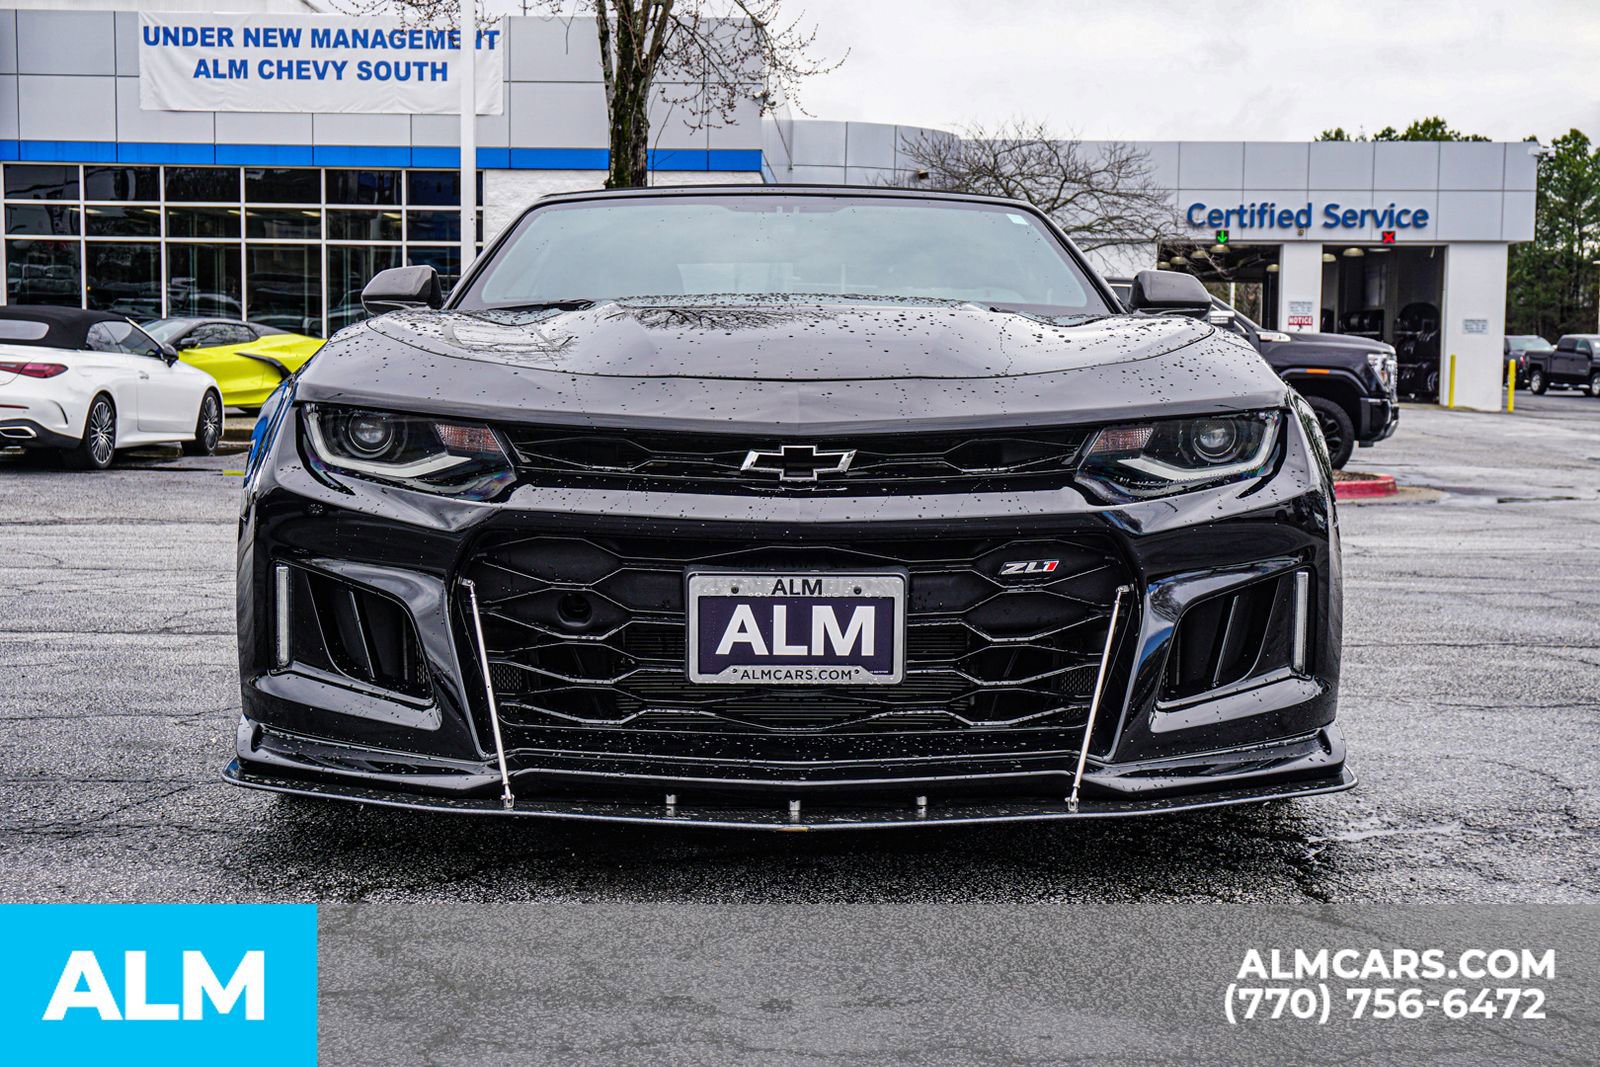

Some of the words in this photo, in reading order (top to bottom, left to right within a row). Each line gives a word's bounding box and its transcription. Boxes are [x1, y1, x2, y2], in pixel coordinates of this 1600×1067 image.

[143, 25, 234, 48] UNDER
[243, 27, 302, 48] NEW
[193, 58, 248, 79] ALM
[257, 59, 348, 80] CHEVY
[357, 60, 448, 82] SOUTH
[1187, 202, 1313, 229] Certified
[1322, 203, 1429, 229] Service
[1288, 316, 1313, 324] NOTICE
[1001, 560, 1060, 575] ZL1
[771, 579, 823, 596] ALM
[715, 604, 875, 657] ALM
[740, 669, 852, 681] ALMCARS.COM
